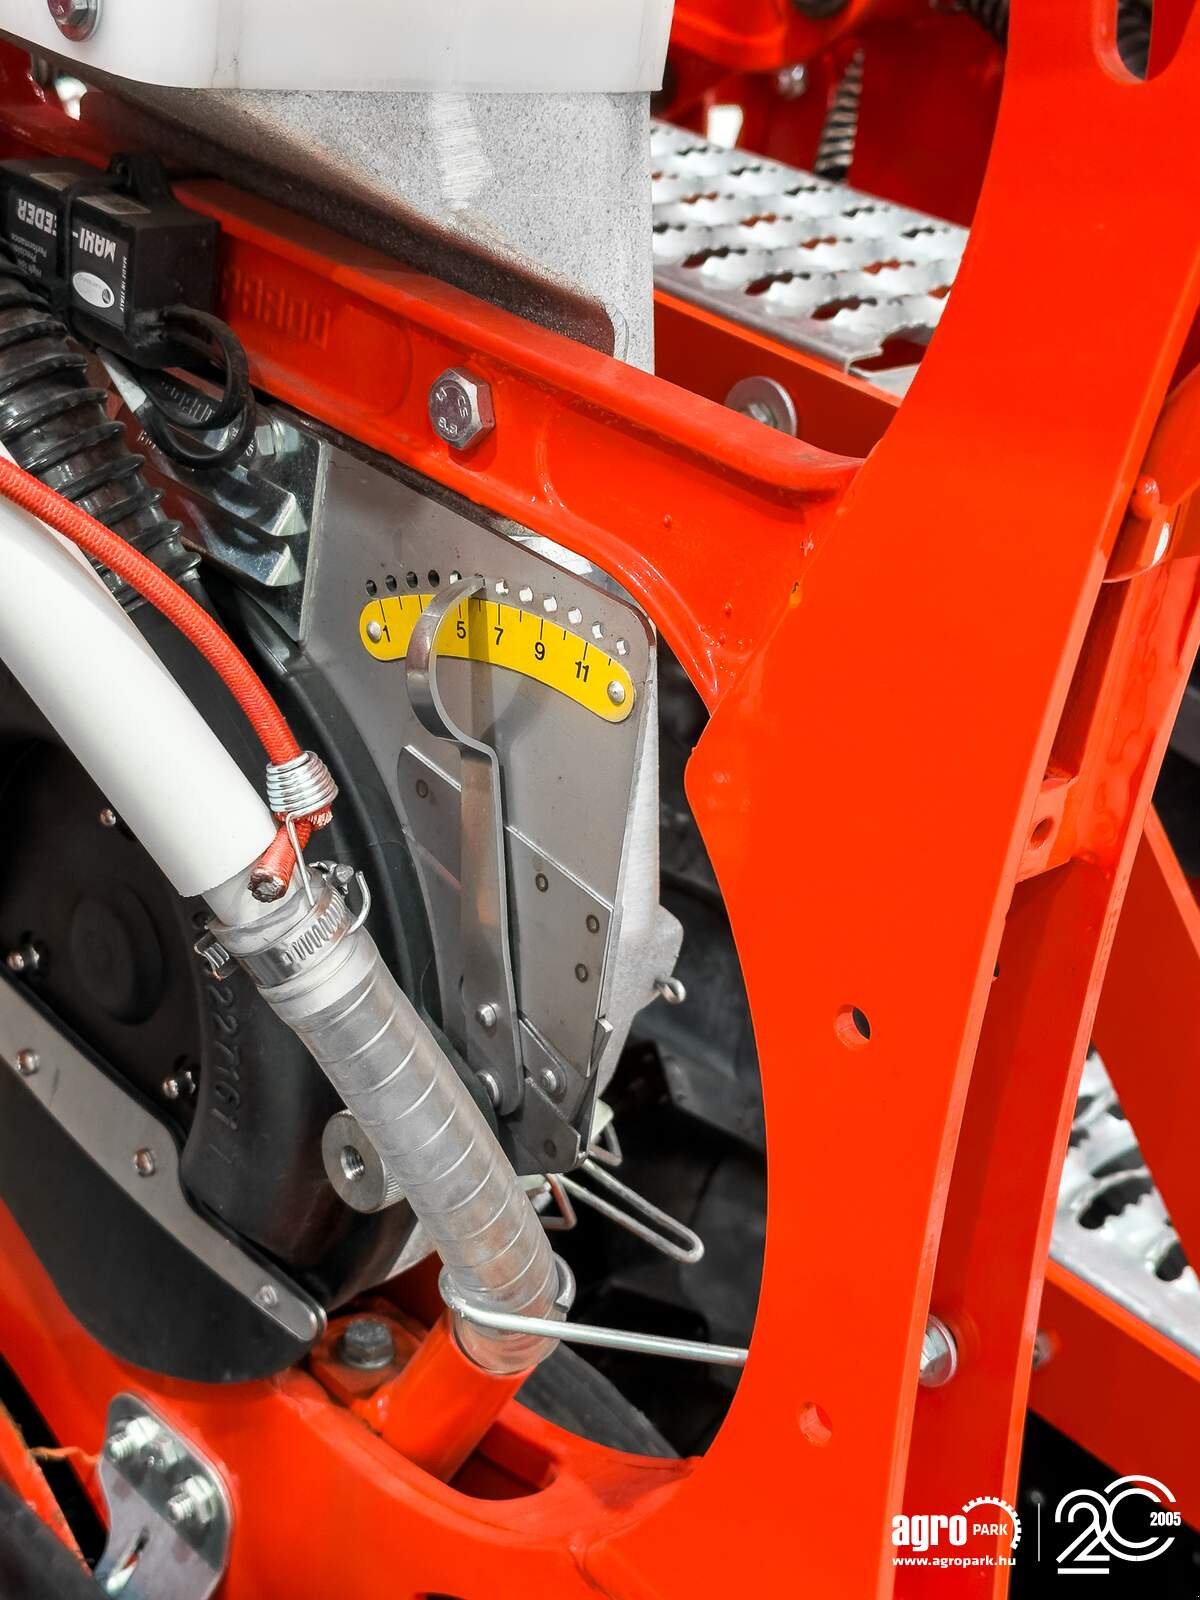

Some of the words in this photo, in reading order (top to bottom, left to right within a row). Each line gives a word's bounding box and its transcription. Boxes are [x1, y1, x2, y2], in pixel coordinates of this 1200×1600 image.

[17, 198, 57, 237] EDER
[382, 624, 391, 643] 1
[456, 620, 467, 639] 5
[494, 626, 504, 645] 7
[534, 642, 546, 661] 9
[575, 660, 591, 683] 11
